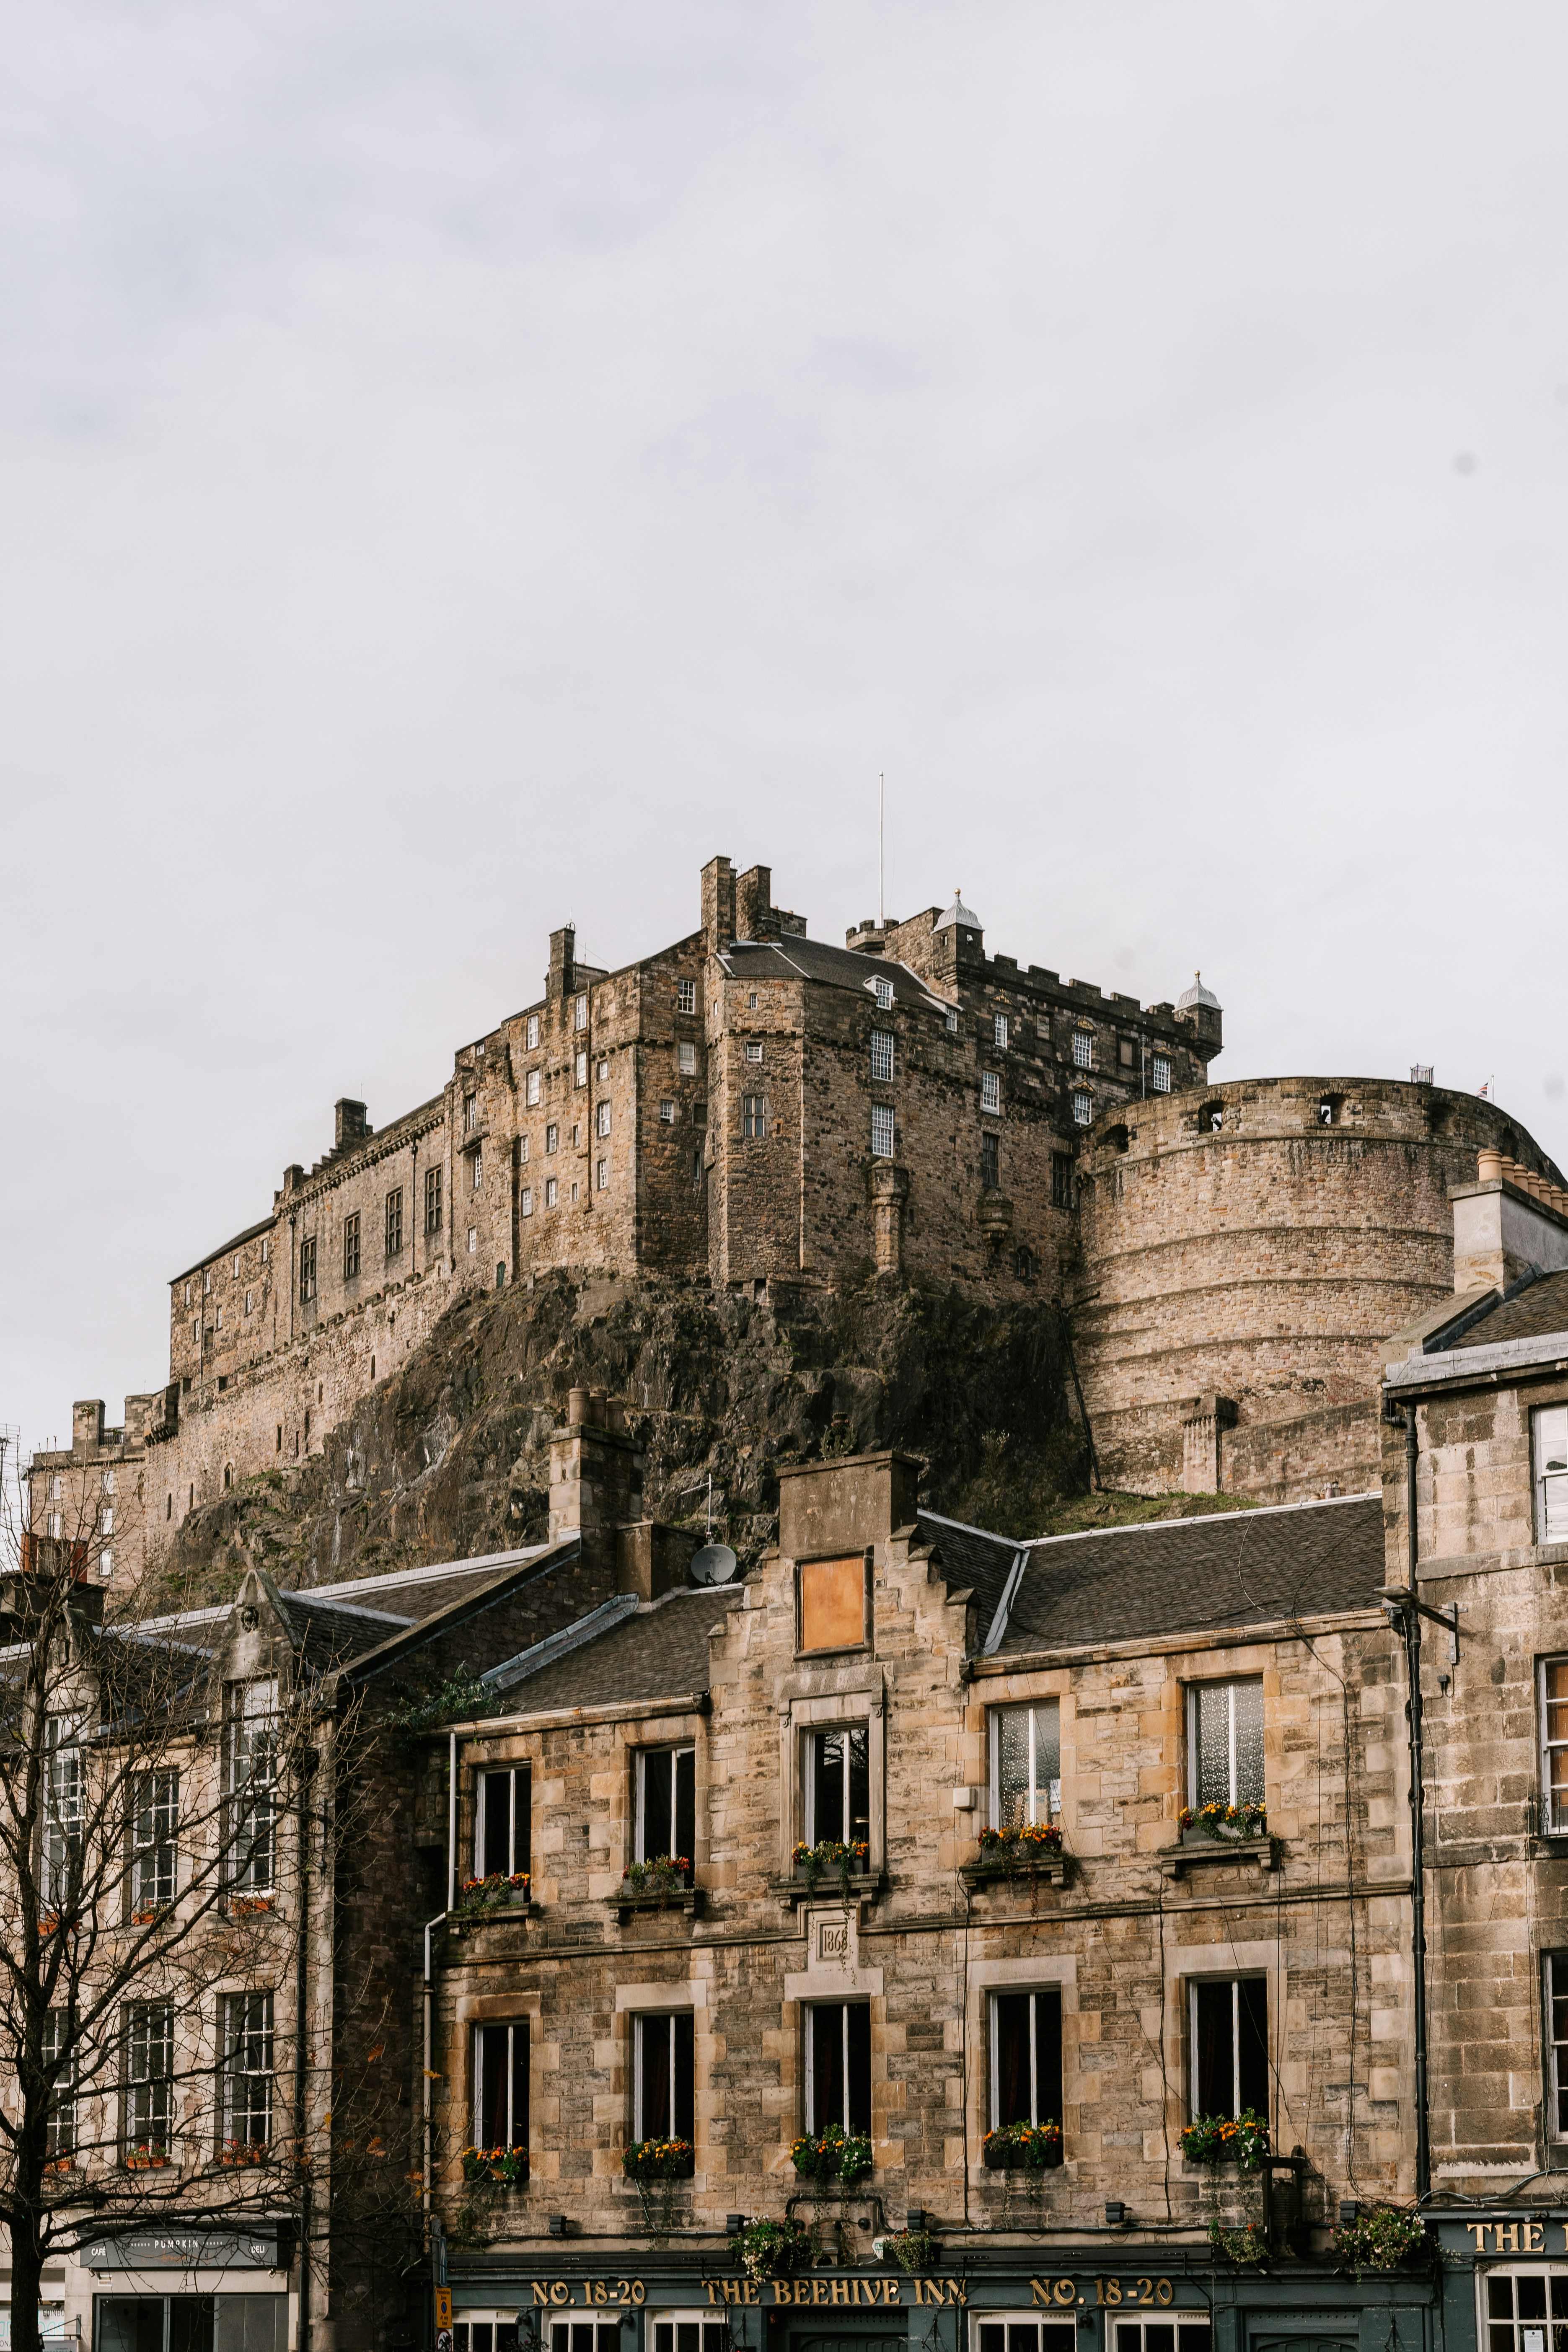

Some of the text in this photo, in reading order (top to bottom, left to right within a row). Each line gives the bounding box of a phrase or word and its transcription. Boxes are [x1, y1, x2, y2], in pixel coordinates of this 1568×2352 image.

[825, 1930, 847, 1951] 1868
[155, 2239, 198, 2249] PUMPKIN
[251, 2245, 265, 2254] DELI
[1467, 2223, 1545, 2253] THE
[91, 2246, 106, 2256] CAFÉ
[531, 2280, 645, 2305] NO. 18-20
[701, 2279, 967, 2305] THE BEEHIVE INN
[1030, 2278, 1172, 2305] NO. 18-20
